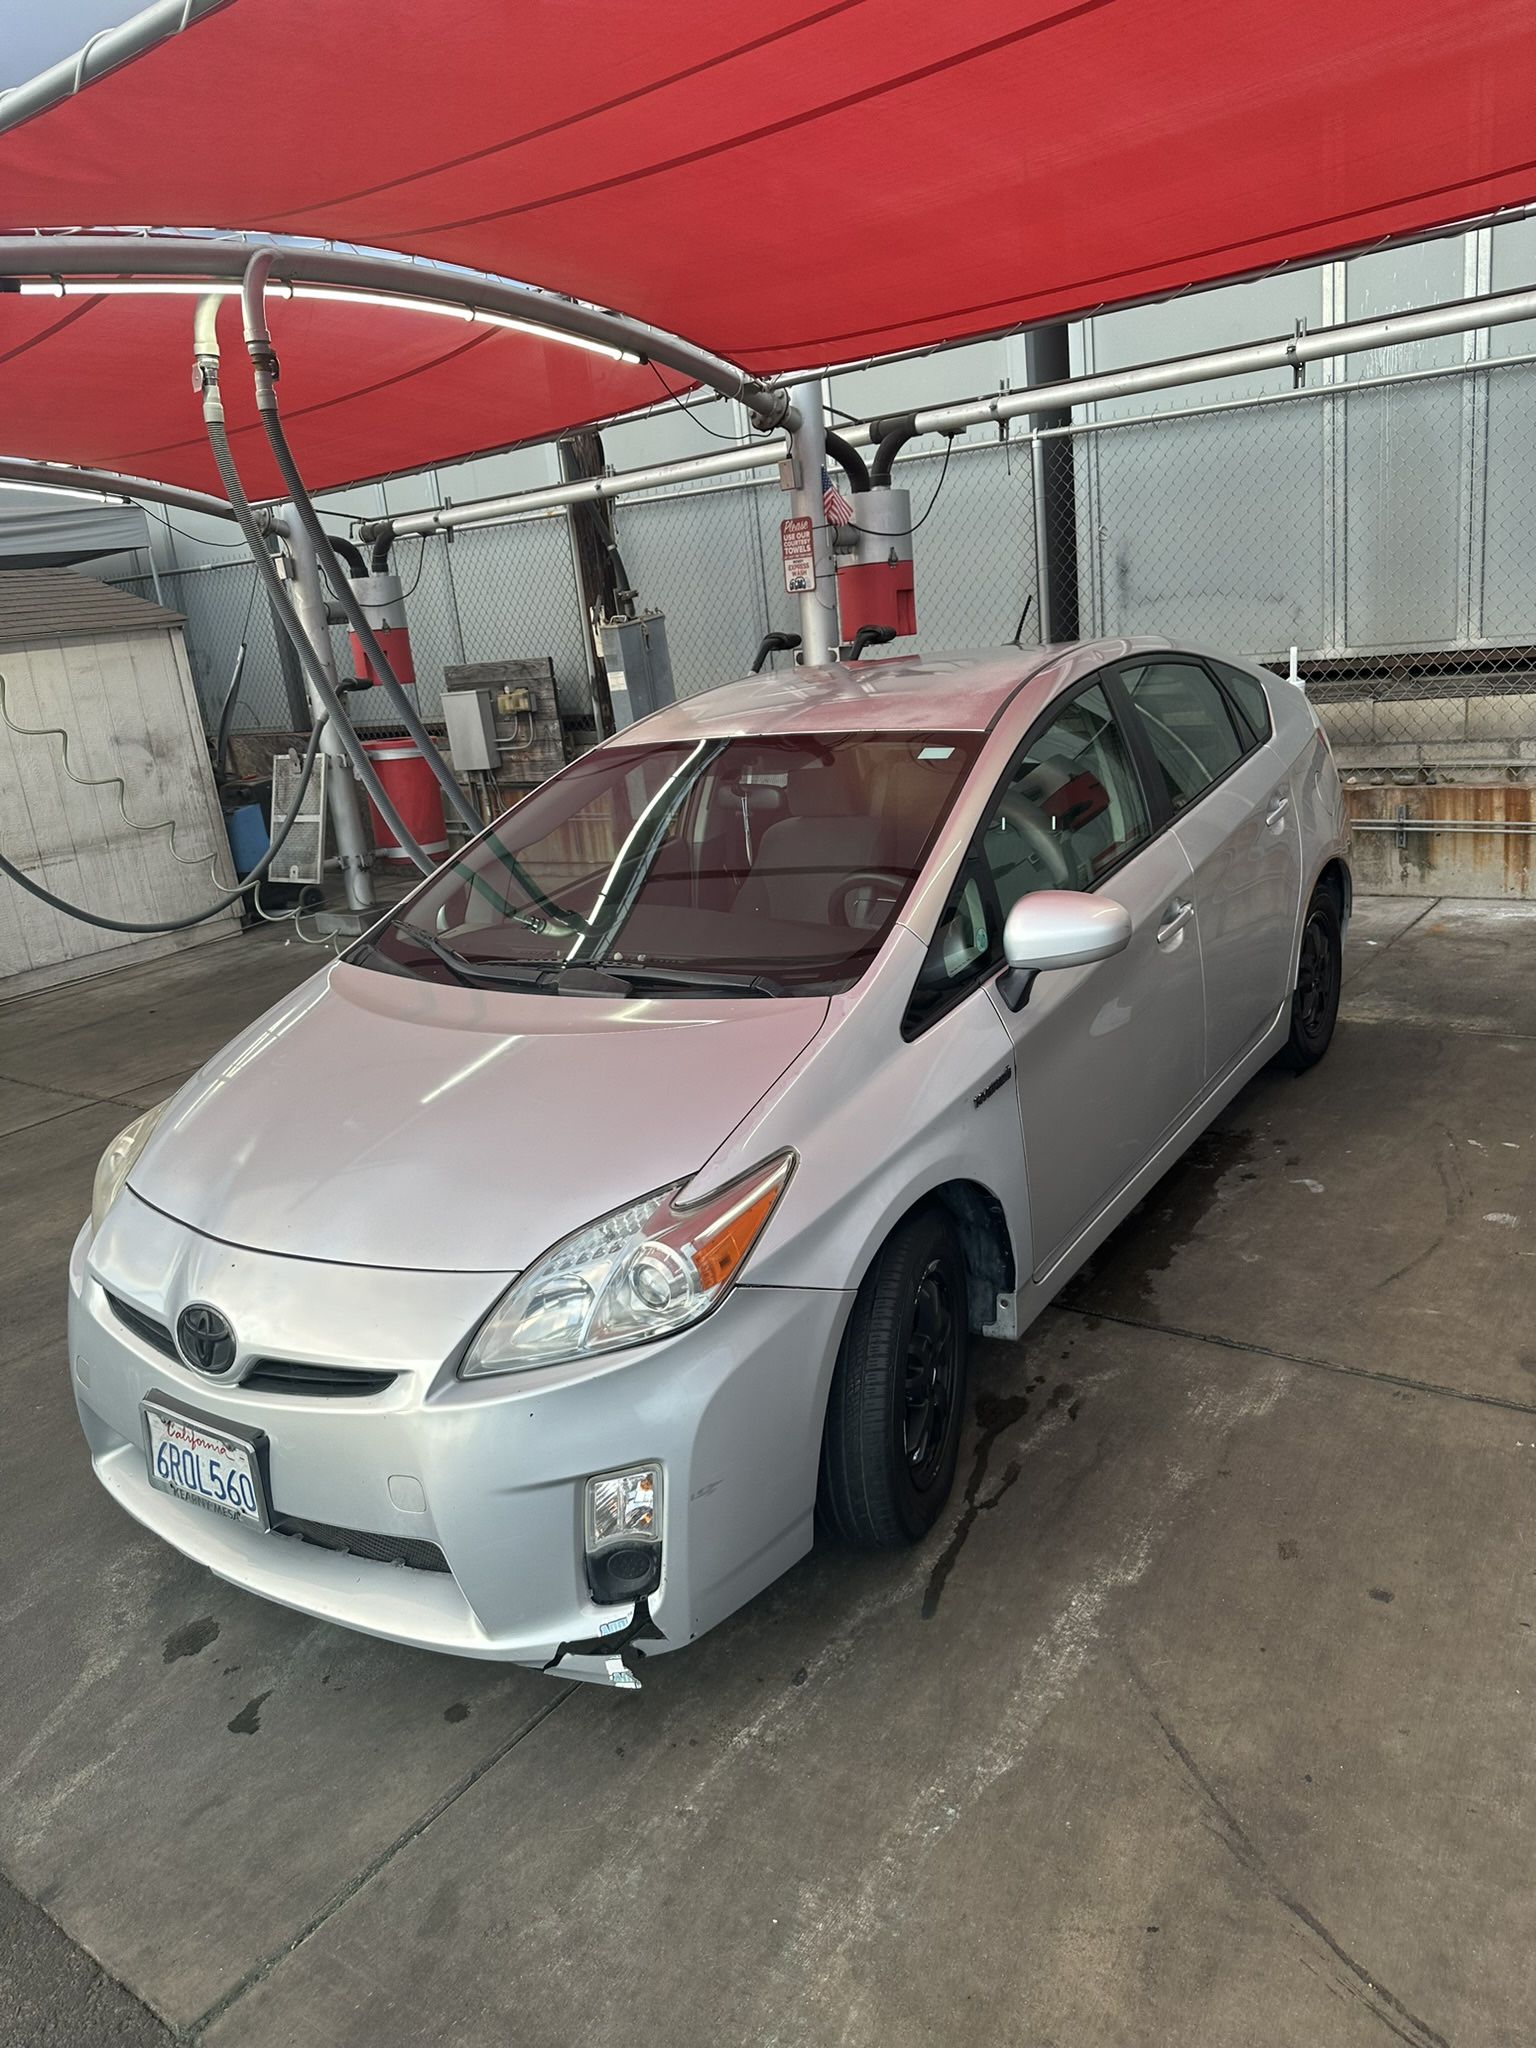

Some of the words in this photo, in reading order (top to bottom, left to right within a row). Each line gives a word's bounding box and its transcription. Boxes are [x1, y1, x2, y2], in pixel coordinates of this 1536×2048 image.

[783, 520, 809, 534] Please
[783, 533, 795, 542] USE
[796, 530, 810, 540] OUR
[783, 538, 811, 547] COURTESY
[784, 544, 812, 555] TOWELS
[788, 562, 810, 571] EXPRESS
[165, 1420, 234, 1461] California
[157, 1441, 257, 1512] 6ROL560
[212, 1502, 241, 1522] MESA
